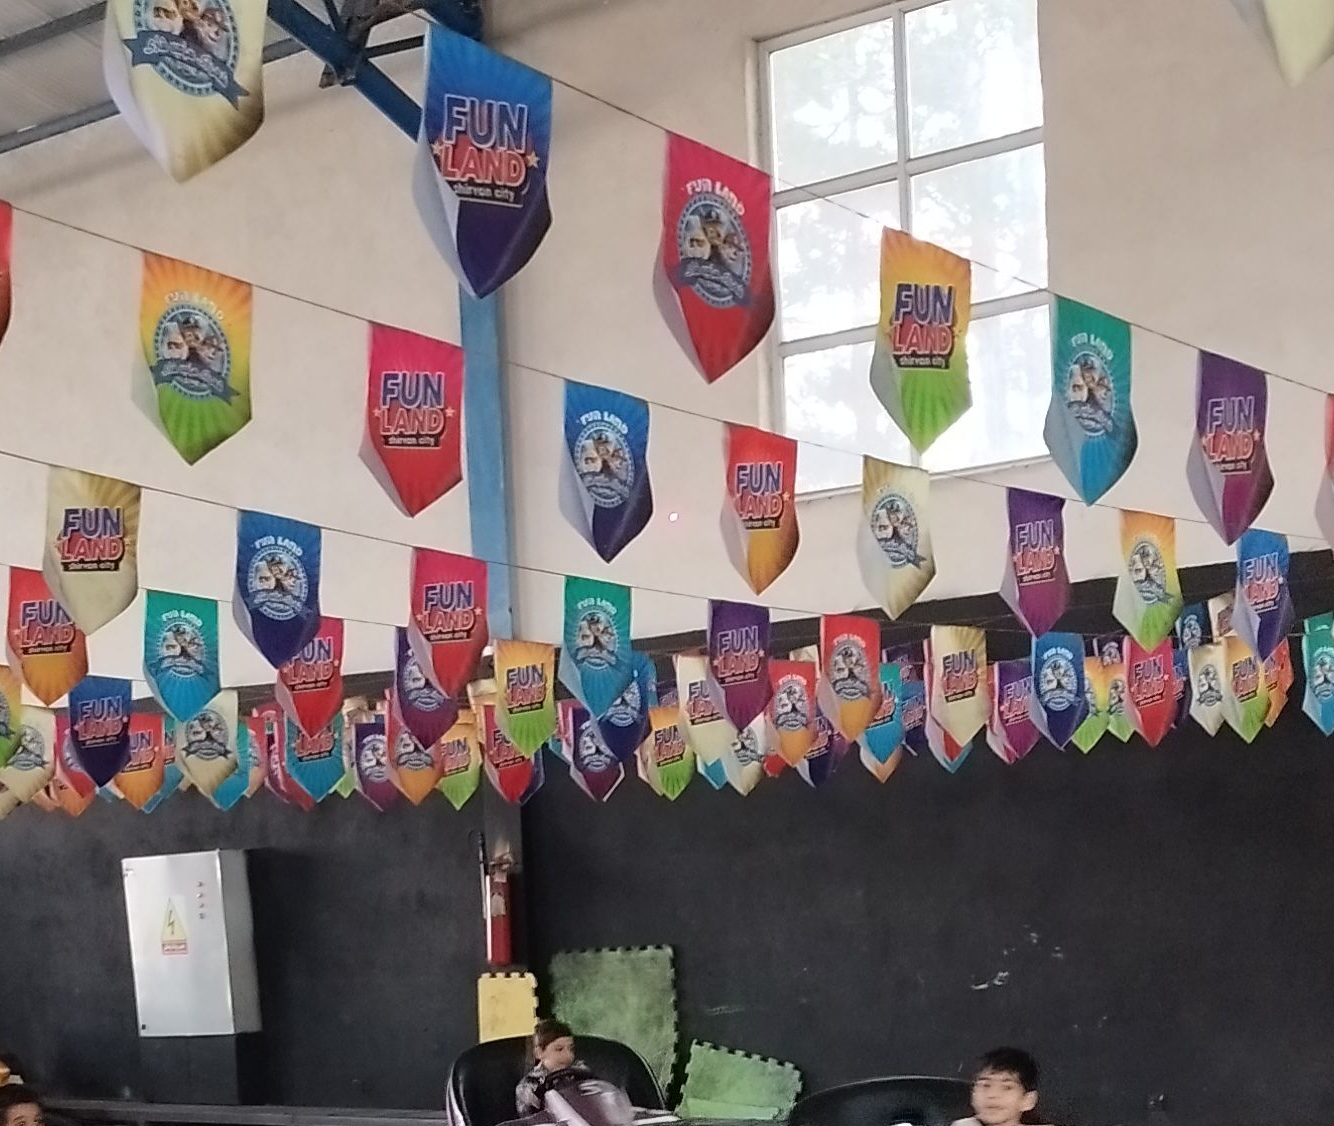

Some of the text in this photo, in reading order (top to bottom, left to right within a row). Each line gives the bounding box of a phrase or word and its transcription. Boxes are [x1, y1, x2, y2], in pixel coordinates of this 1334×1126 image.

[442, 93, 528, 153] FUN
[440, 143, 526, 187] LAND
[686, 178, 713, 195] FUN
[895, 282, 955, 326] FUN
[893, 322, 953, 355] LAND
[932, 356, 946, 369] city
[381, 370, 445, 409] FUN
[379, 407, 445, 435] LAND
[1207, 396, 1255, 434] FUN
[1208, 431, 1254, 463] LAND
[735, 461, 783, 496] FUN
[735, 493, 784, 520] LAND
[63, 506, 124, 538] FUN
[1016, 518, 1055, 551] FUN
[60, 536, 125, 562] LAND
[255, 536, 276, 549] FUN
[1243, 552, 1280, 583] FUN
[423, 581, 474, 612] FUN
[20, 600, 73, 627] FUN
[423, 608, 475, 635] LAND
[20, 622, 76, 647] LAND
[717, 626, 759, 658] FUN
[287, 657, 334, 685] LAND
[717, 653, 760, 678] LAND
[942, 649, 977, 675] FUN
[506, 663, 545, 691] FUN
[688, 680, 709, 702] FU
[78, 696, 123, 721] FUN
